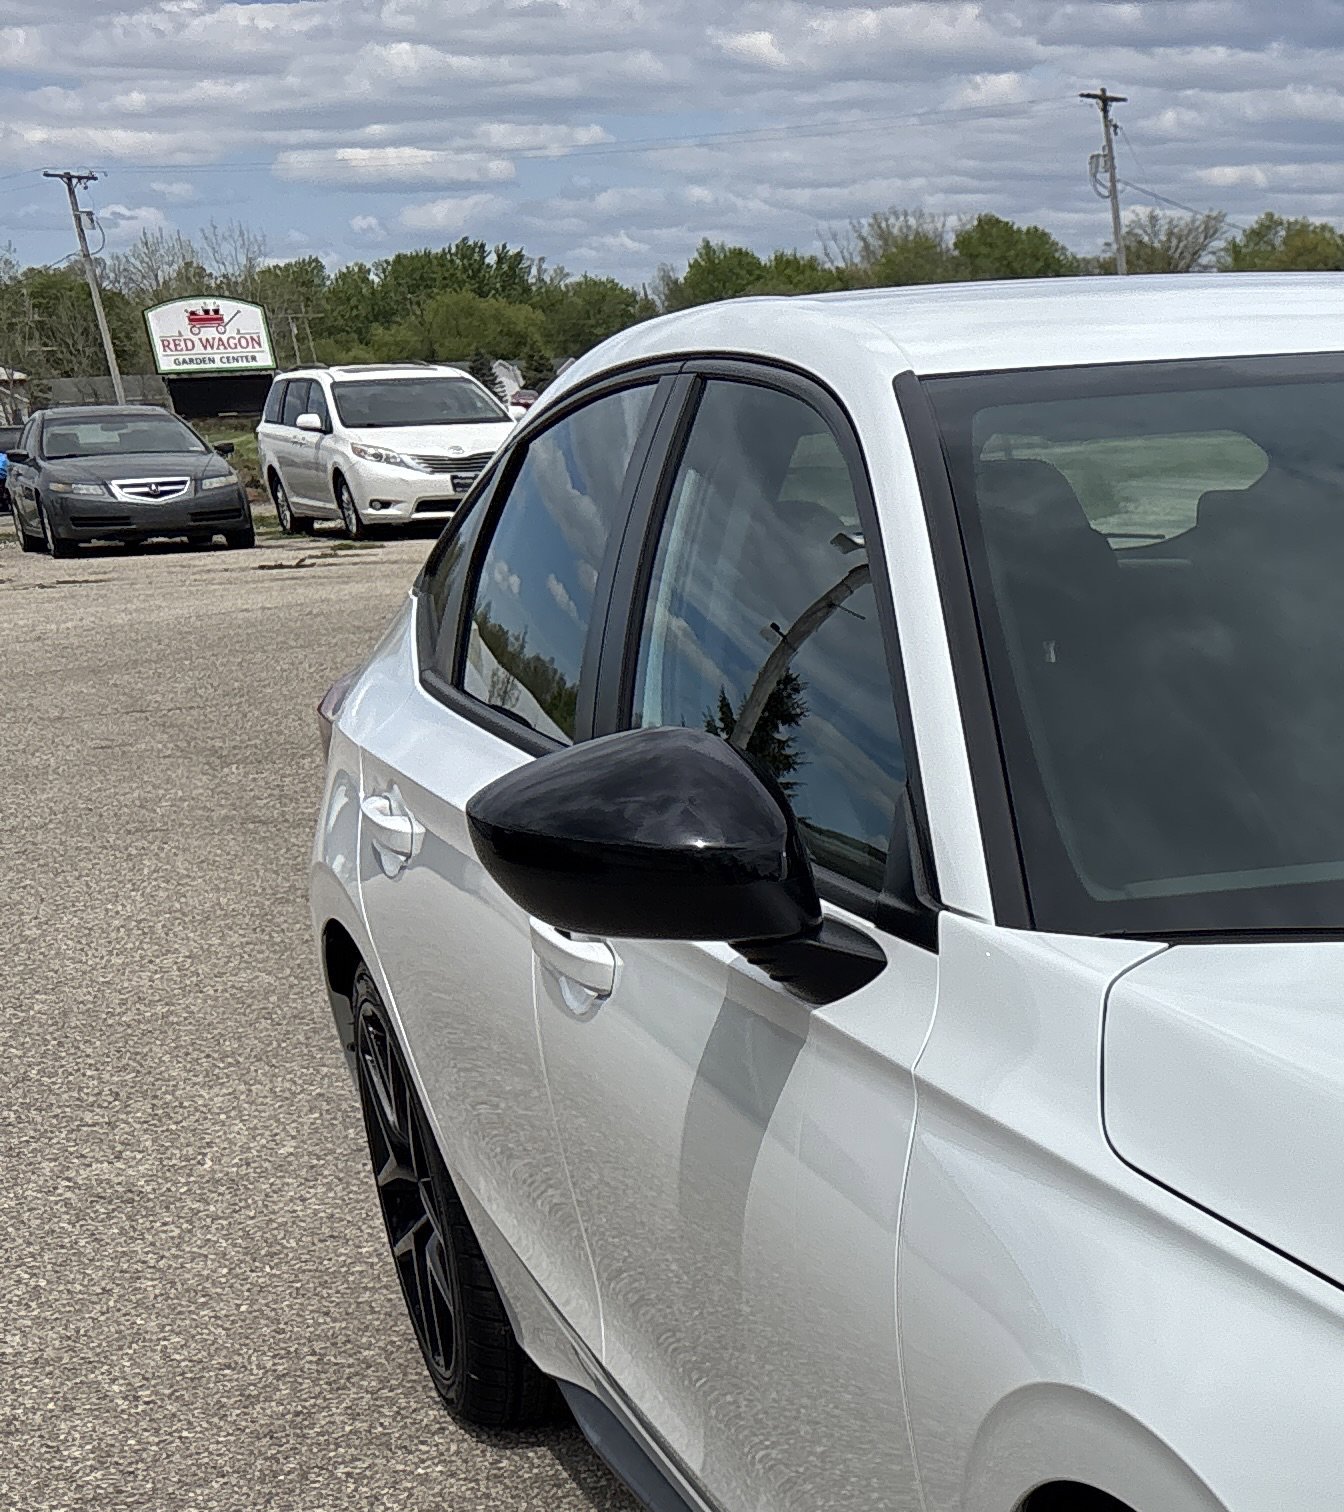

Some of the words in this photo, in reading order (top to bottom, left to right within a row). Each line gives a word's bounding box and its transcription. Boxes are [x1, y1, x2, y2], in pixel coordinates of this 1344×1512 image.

[160, 338, 195, 352] RED
[198, 335, 262, 351] WAGON
[173, 357, 215, 366] GARDEN
[220, 355, 257, 364] CENTER
